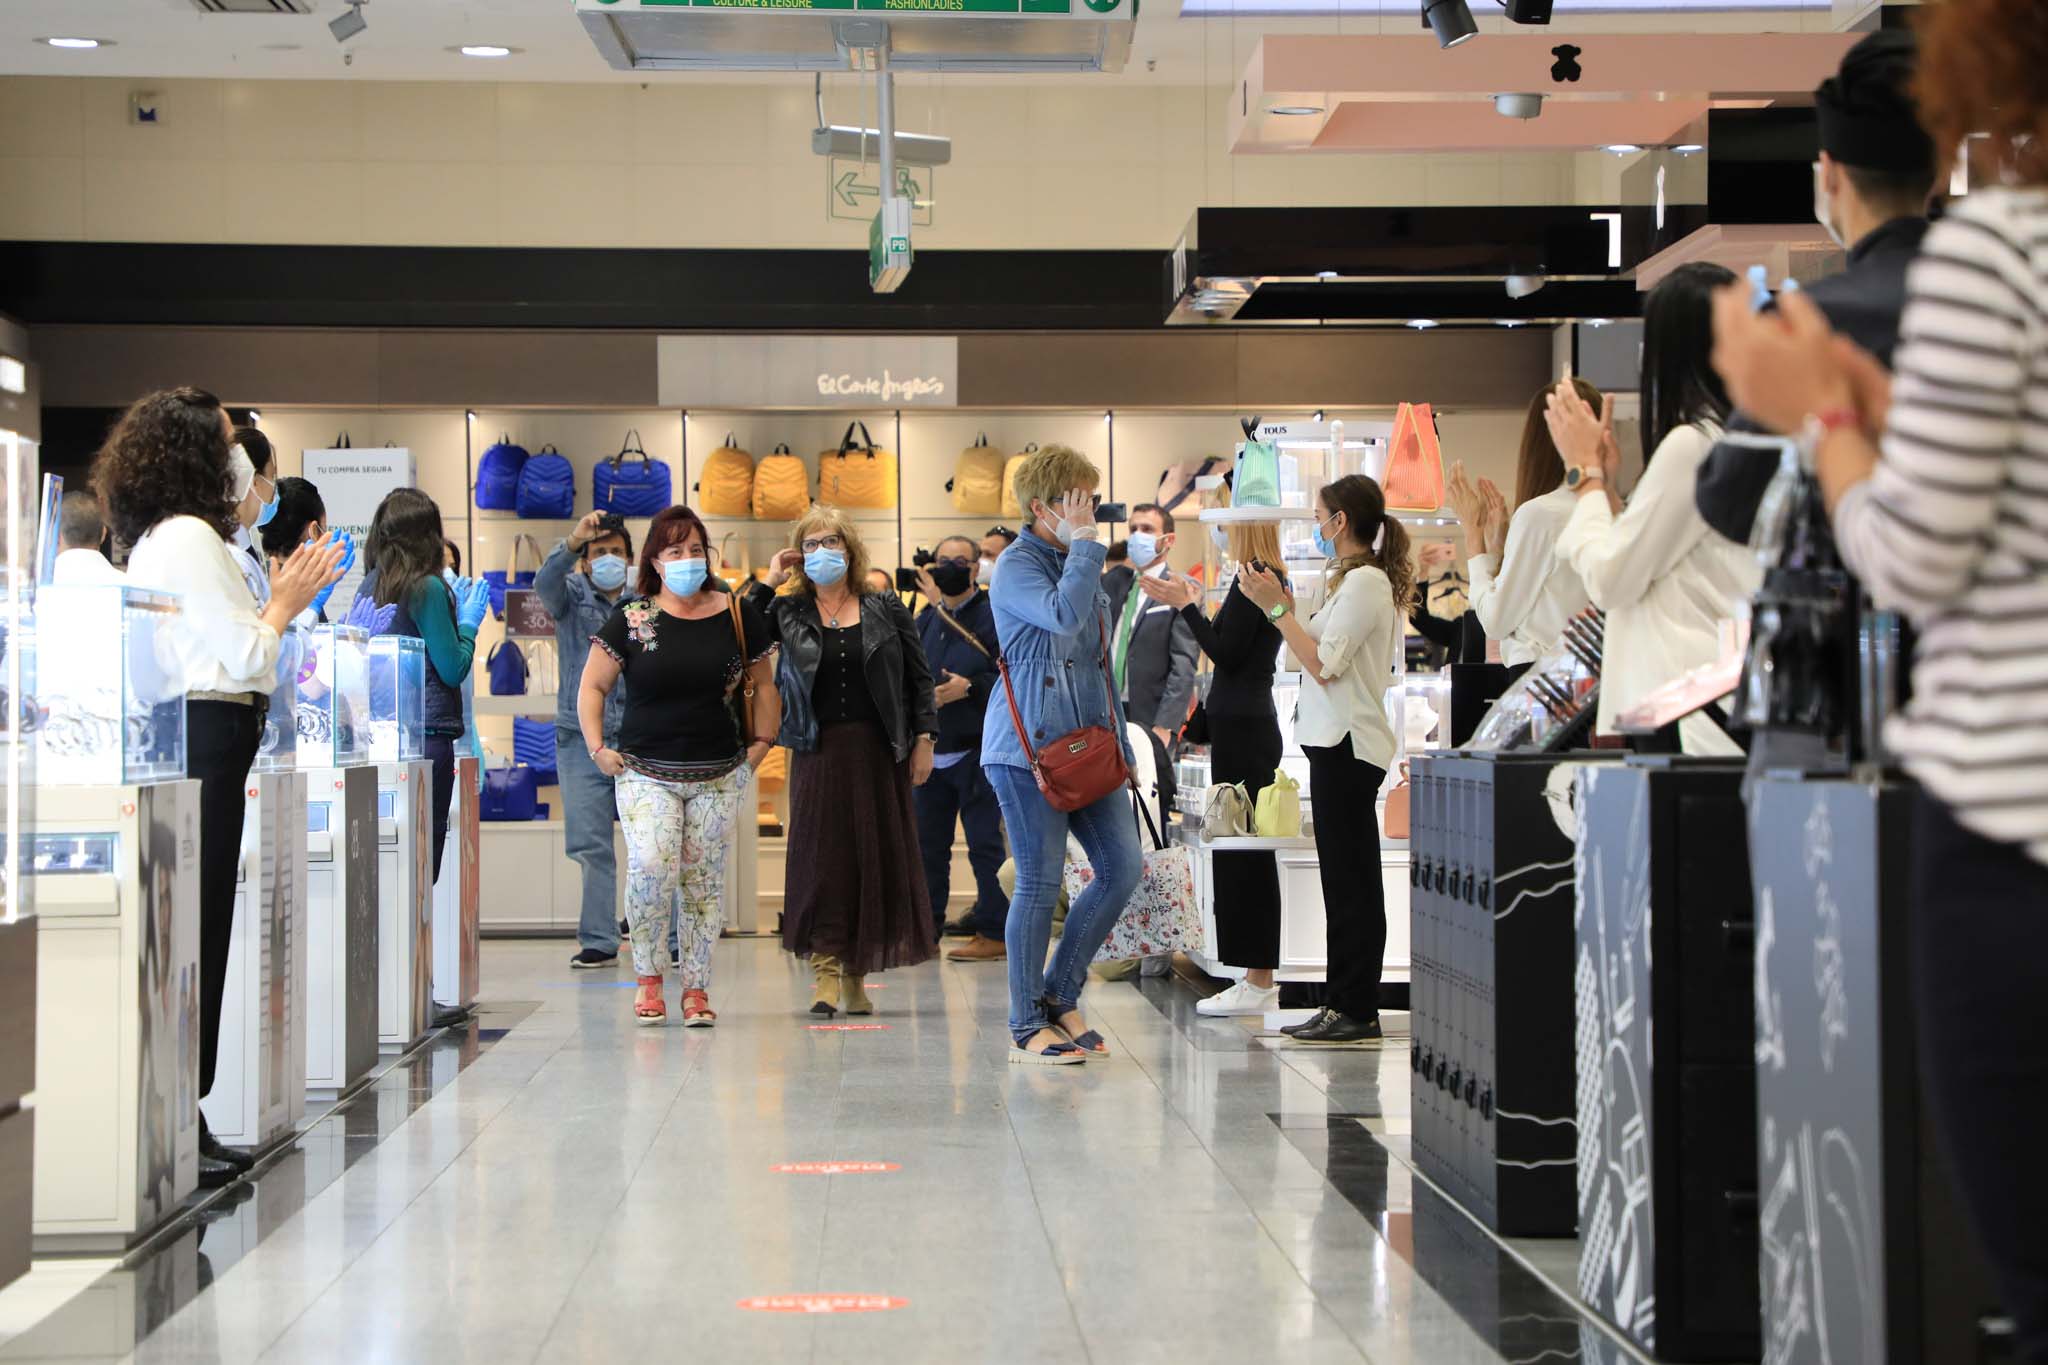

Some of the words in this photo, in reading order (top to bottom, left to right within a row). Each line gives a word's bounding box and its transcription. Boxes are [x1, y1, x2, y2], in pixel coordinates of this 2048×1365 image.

[770, 0, 813, 8] LEISURE
[892, 239, 905, 251] PB
[817, 373, 836, 395] El
[837, 374, 880, 395] Corte
[1264, 426, 1287, 434] TOUS
[317, 466, 327, 474] TU
[328, 465, 360, 474] COMPRA
[362, 465, 392, 474] SEGURA
